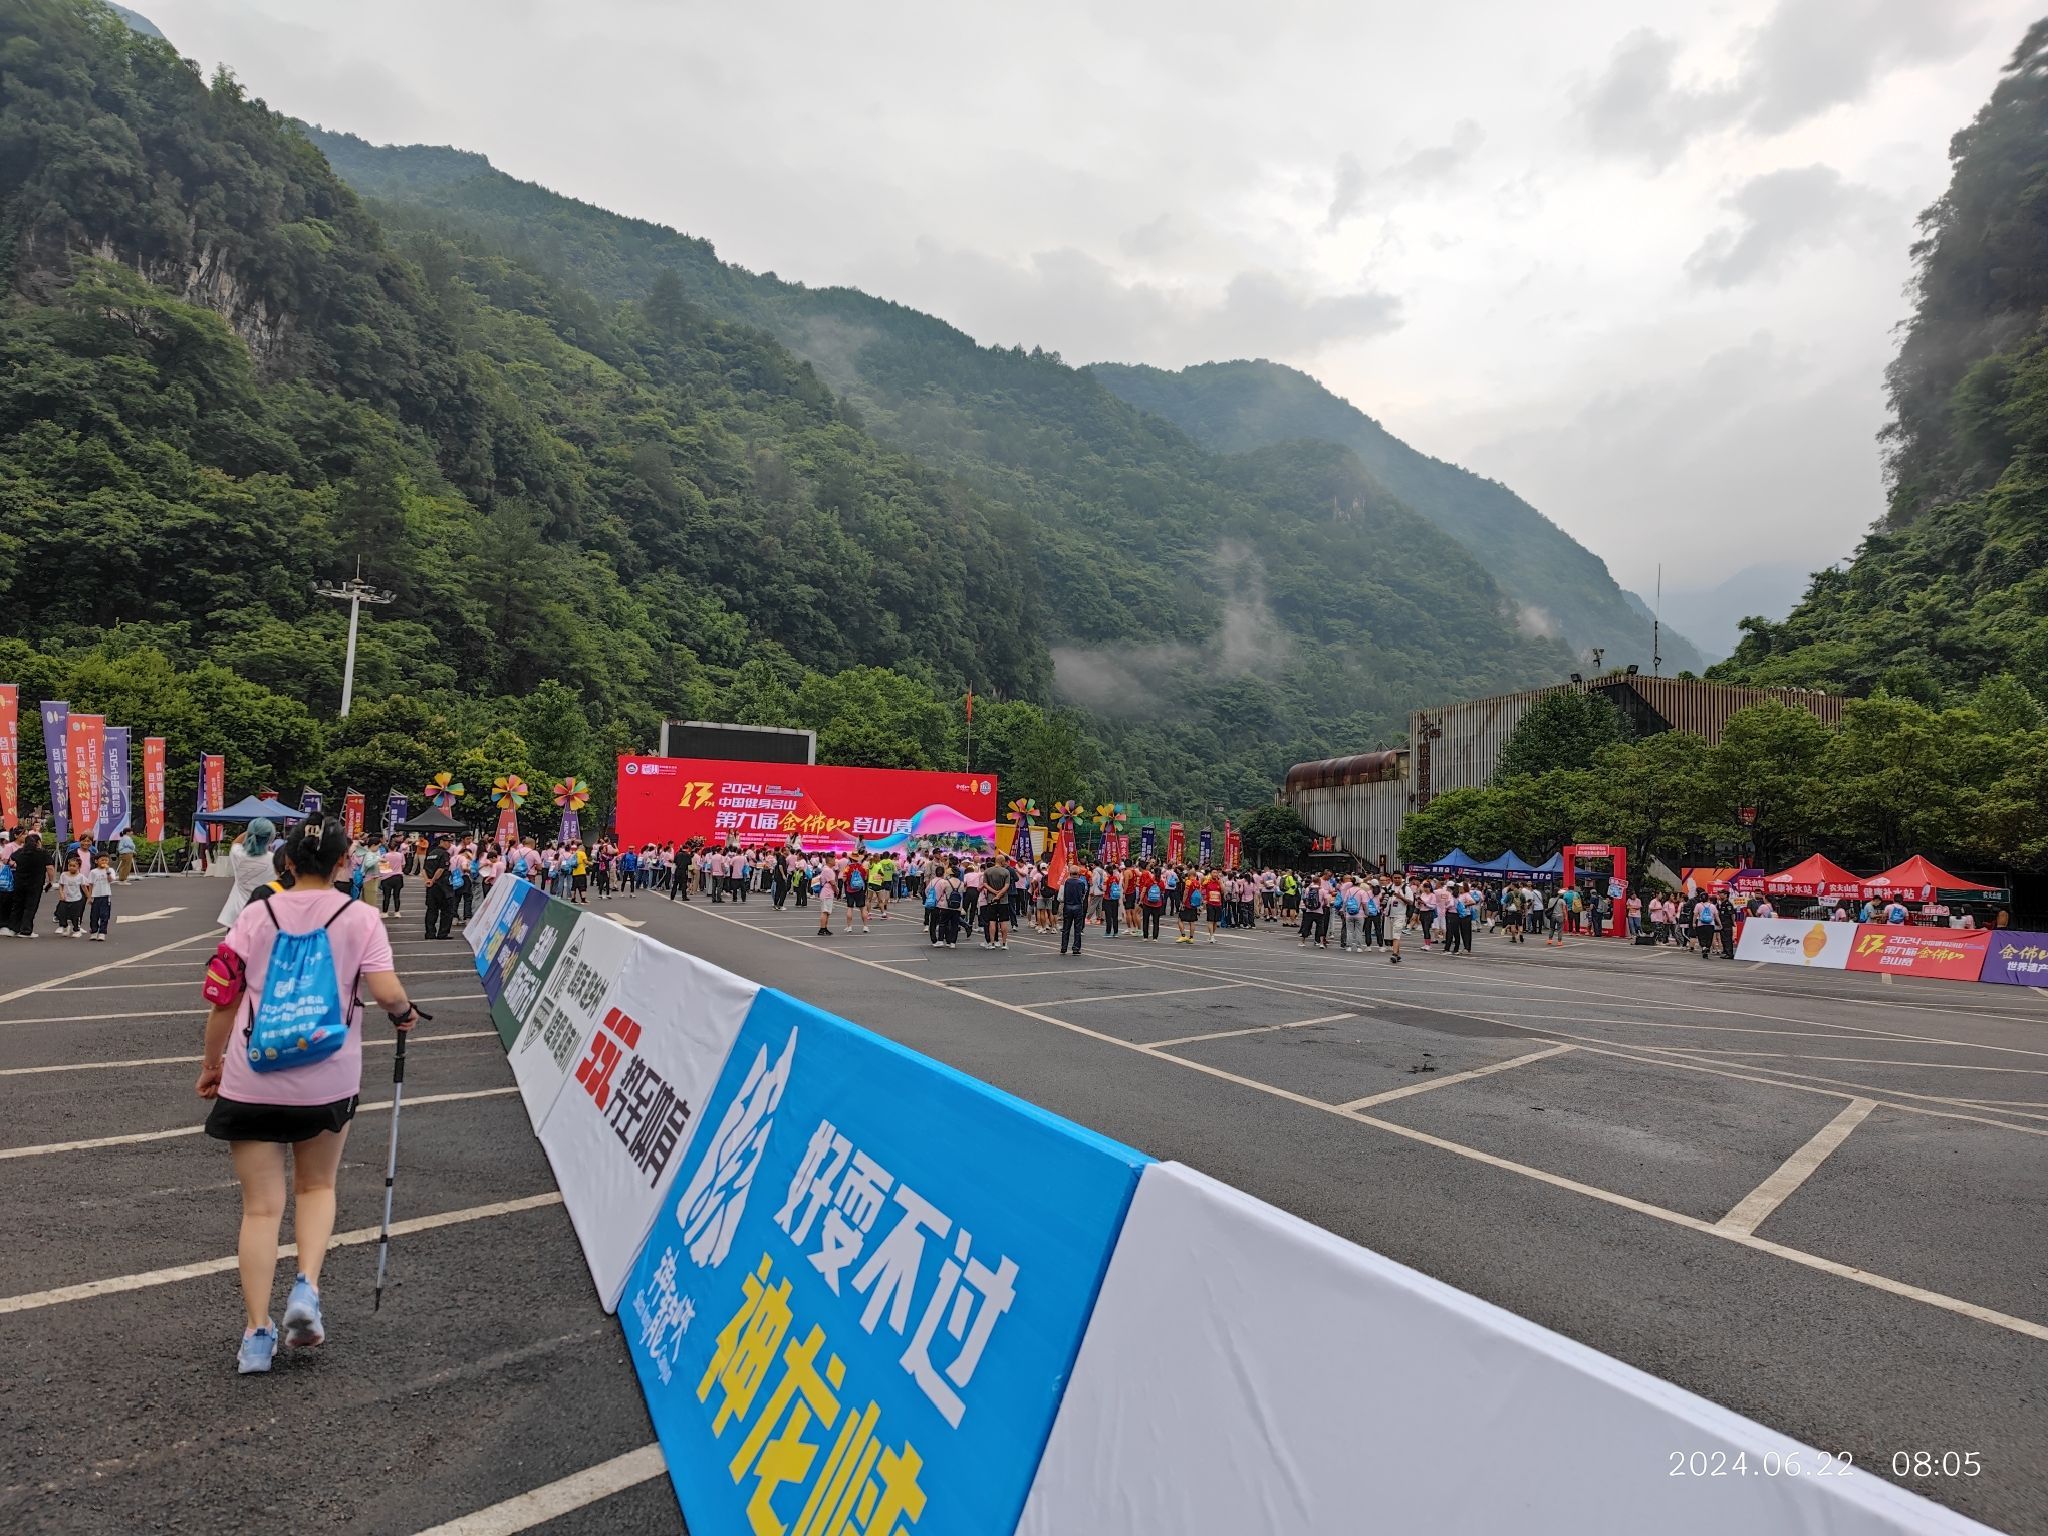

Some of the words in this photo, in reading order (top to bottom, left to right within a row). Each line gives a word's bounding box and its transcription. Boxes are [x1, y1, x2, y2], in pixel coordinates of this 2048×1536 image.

[721, 782, 762, 795] 2024
[718, 797, 797, 811] 中国健身名山
[1767, 882, 1813, 895] 健康补水站
[1761, 933, 1801, 948] 金佛山
[605, 1054, 690, 1189] 势至体育
[774, 1119, 1020, 1430] 好耍不过
[696, 1251, 928, 1536] 神龙峡
